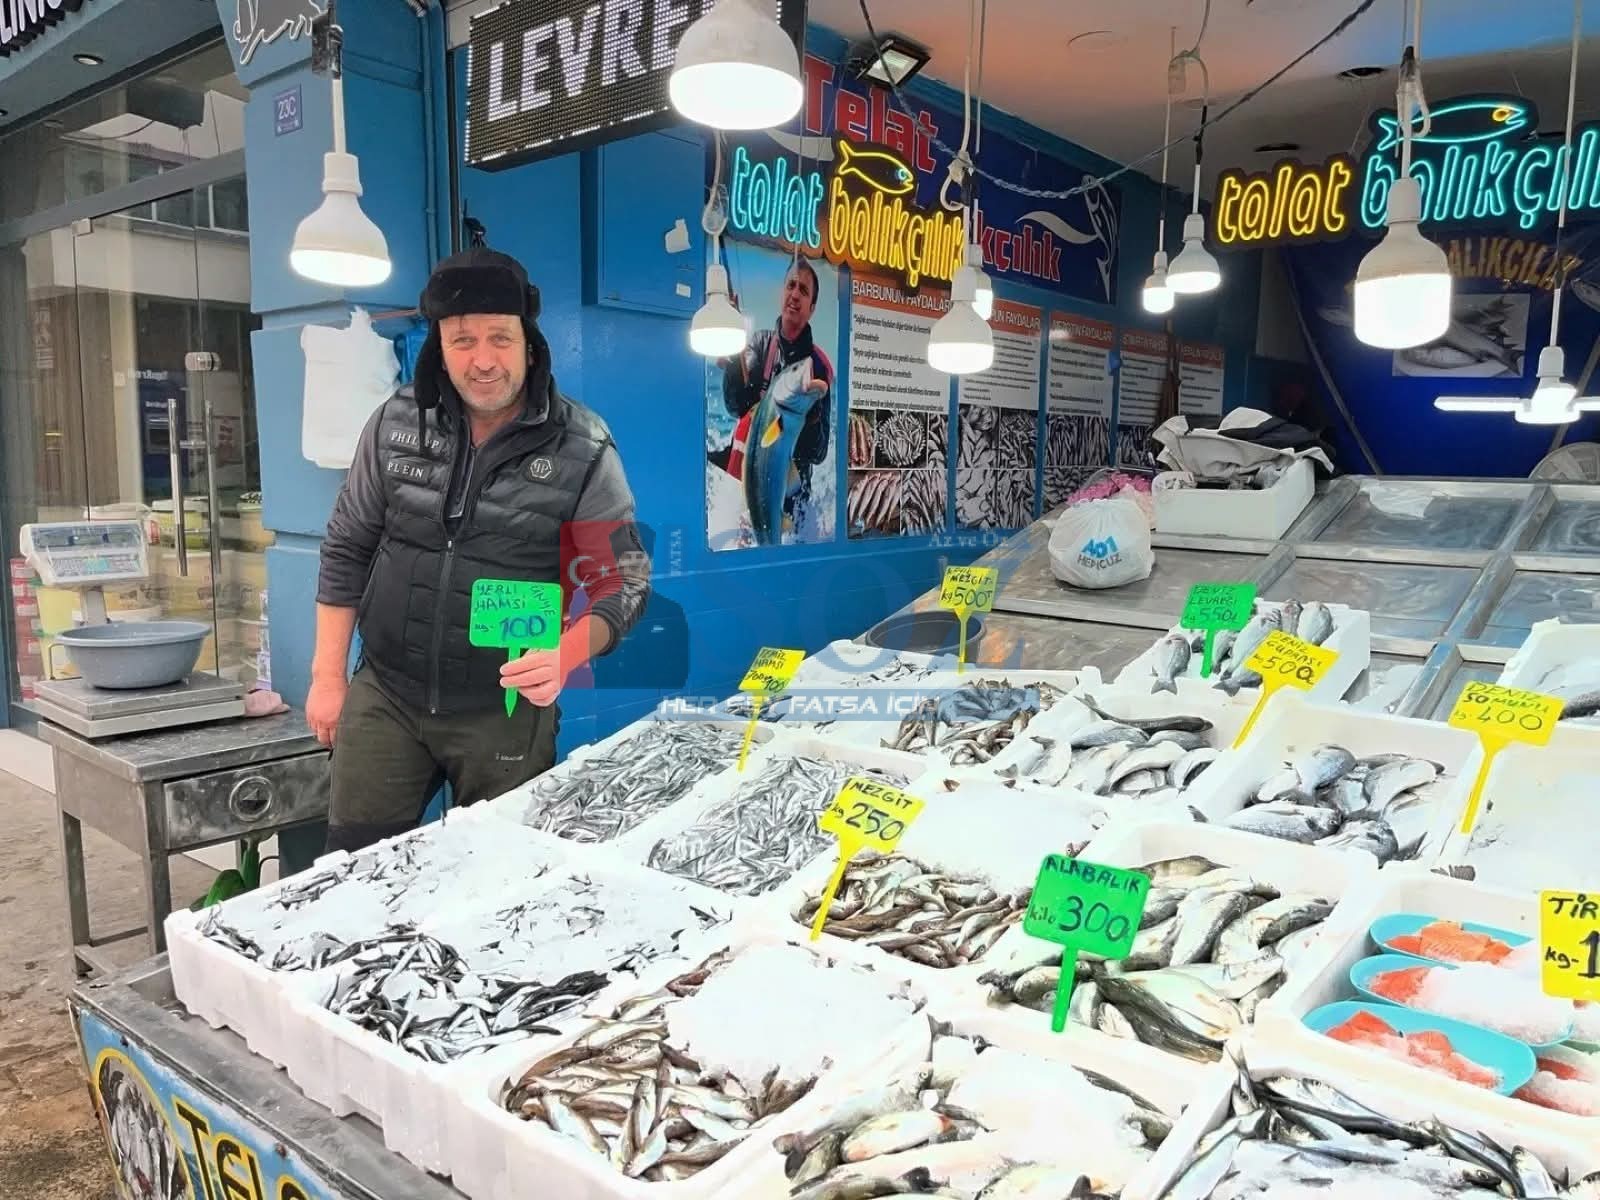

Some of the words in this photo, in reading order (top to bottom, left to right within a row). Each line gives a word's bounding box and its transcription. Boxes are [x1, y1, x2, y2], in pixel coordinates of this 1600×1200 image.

[487, 0, 714, 121] LEVRE
[731, 146, 823, 249] talat
[1217, 160, 1350, 244] talat
[387, 462, 424, 478] PLEIN
[499, 616, 546, 642] 100
[1477, 706, 1543, 731] 400
[845, 802, 905, 841] 250
[1045, 857, 1141, 894] ALABALIK
[1029, 905, 1056, 924] kilo
[1058, 896, 1130, 942] 300
